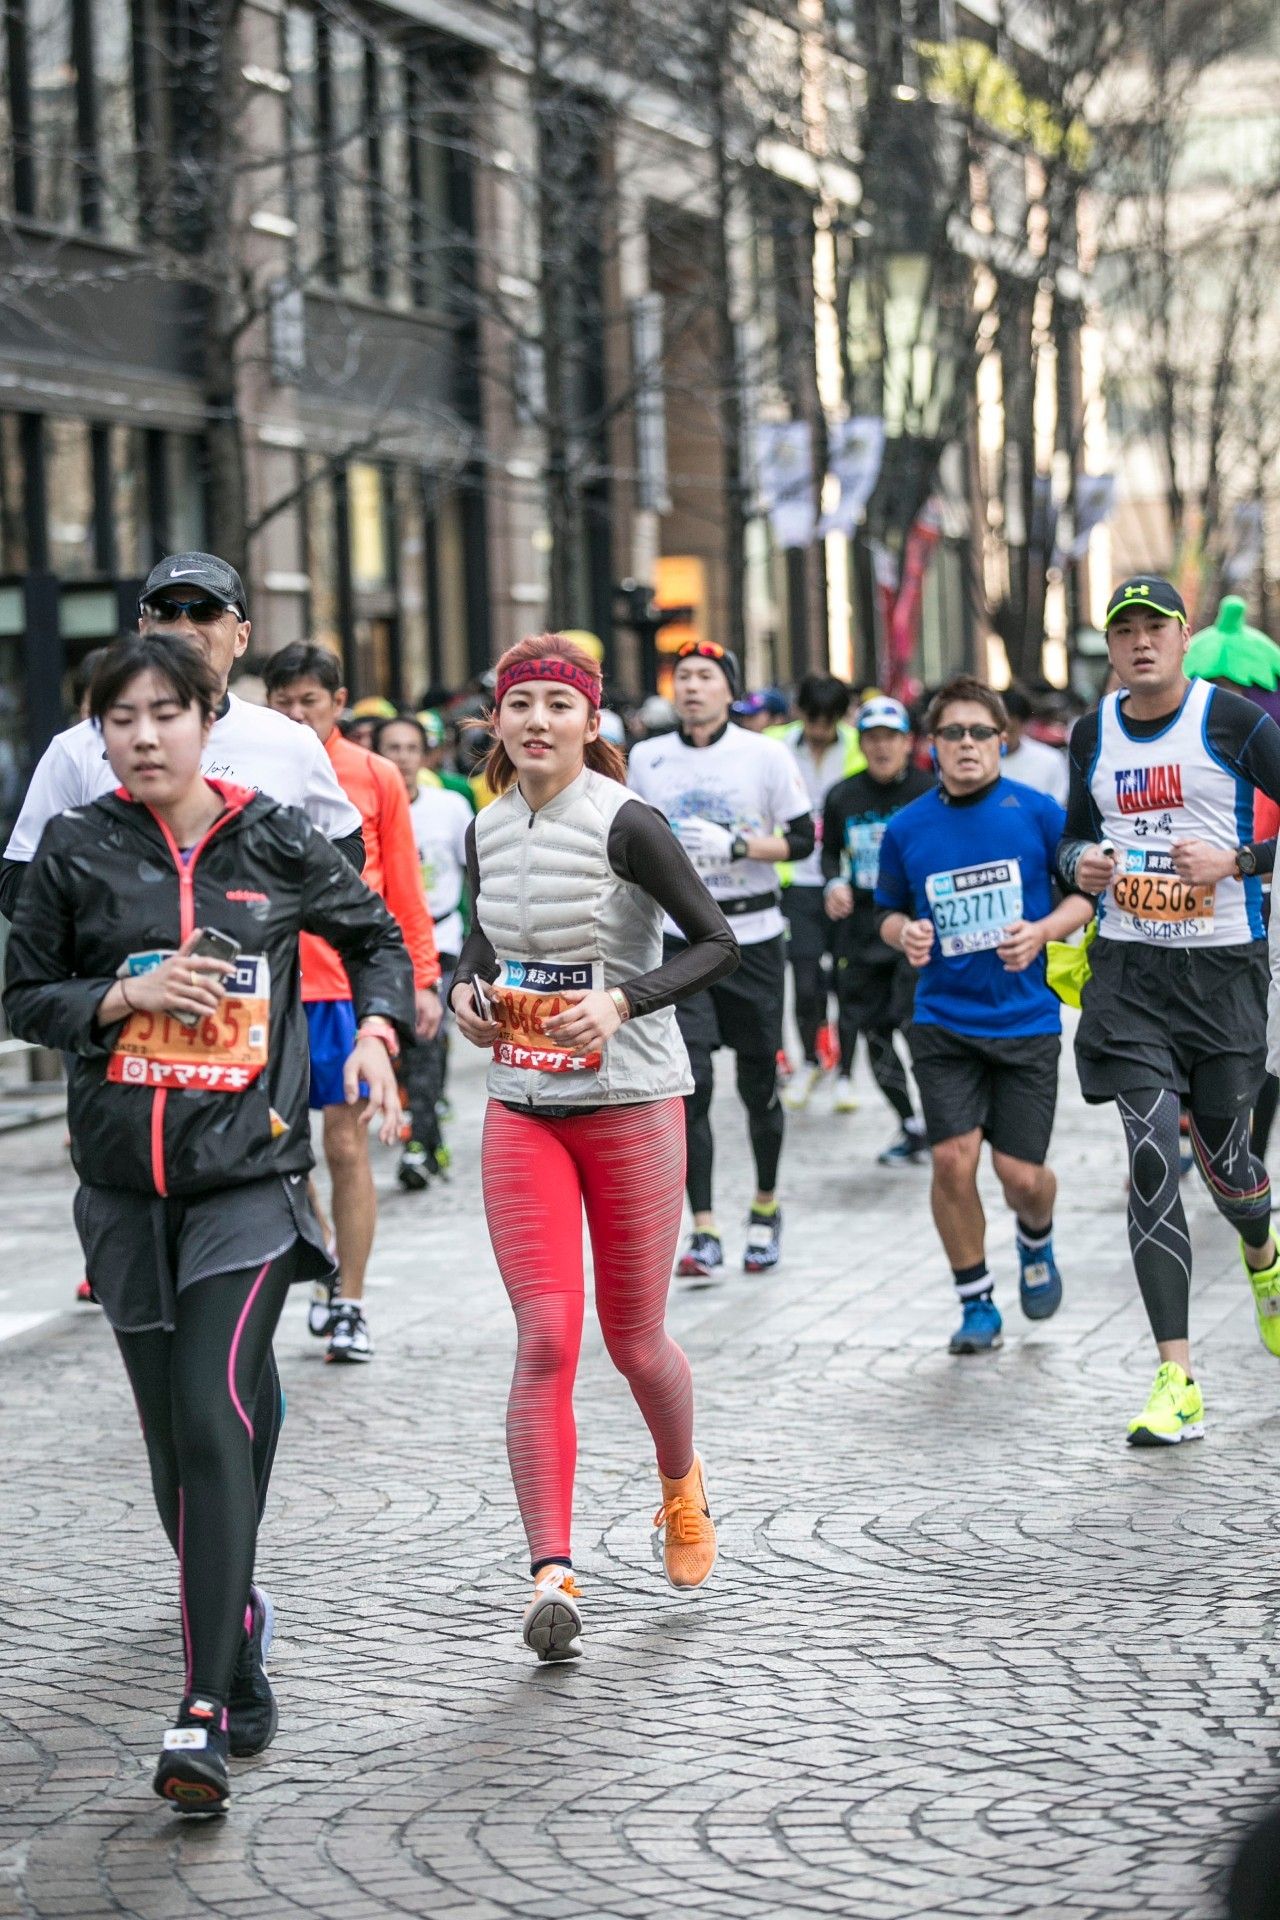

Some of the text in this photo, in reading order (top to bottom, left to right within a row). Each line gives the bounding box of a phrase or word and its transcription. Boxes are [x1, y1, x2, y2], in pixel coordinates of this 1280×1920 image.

[1115, 764, 1184, 814] TAIWAN
[934, 890, 1006, 929] G23771
[1113, 877, 1196, 912] G82506
[526, 968, 587, 985] 東京メトロ
[149, 1062, 250, 1087] ヤマザキ
[514, 1048, 587, 1071] ヤマザキ
